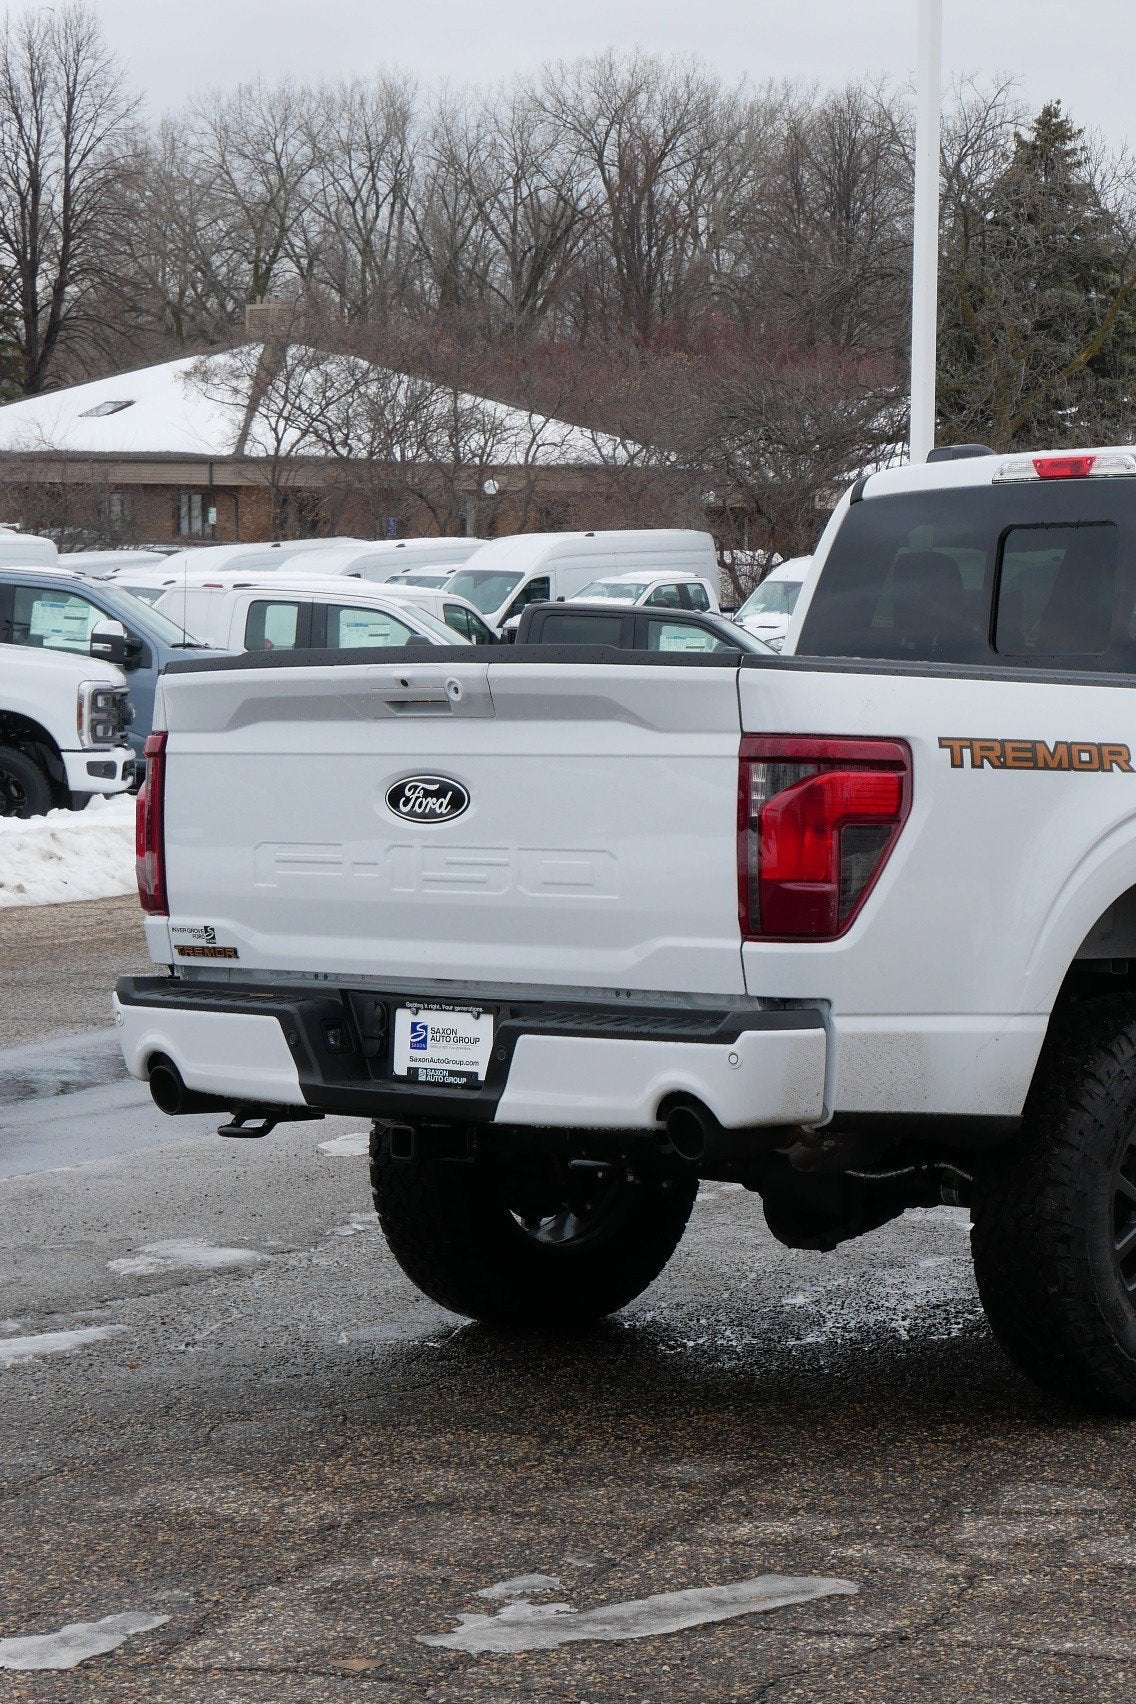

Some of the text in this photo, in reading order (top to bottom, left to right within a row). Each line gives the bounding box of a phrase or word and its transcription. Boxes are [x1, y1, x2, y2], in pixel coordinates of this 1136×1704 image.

[938, 737, 1136, 773] TREMOR
[399, 782, 453, 813] Ford
[253, 841, 619, 899] F-150
[174, 945, 239, 958] TREMOR
[430, 1027, 458, 1036] SAXON
[453, 1036, 480, 1044] GROUP
[409, 1056, 479, 1066] SaxonAutoGroup.com
[426, 1069, 449, 1077] SAXON
